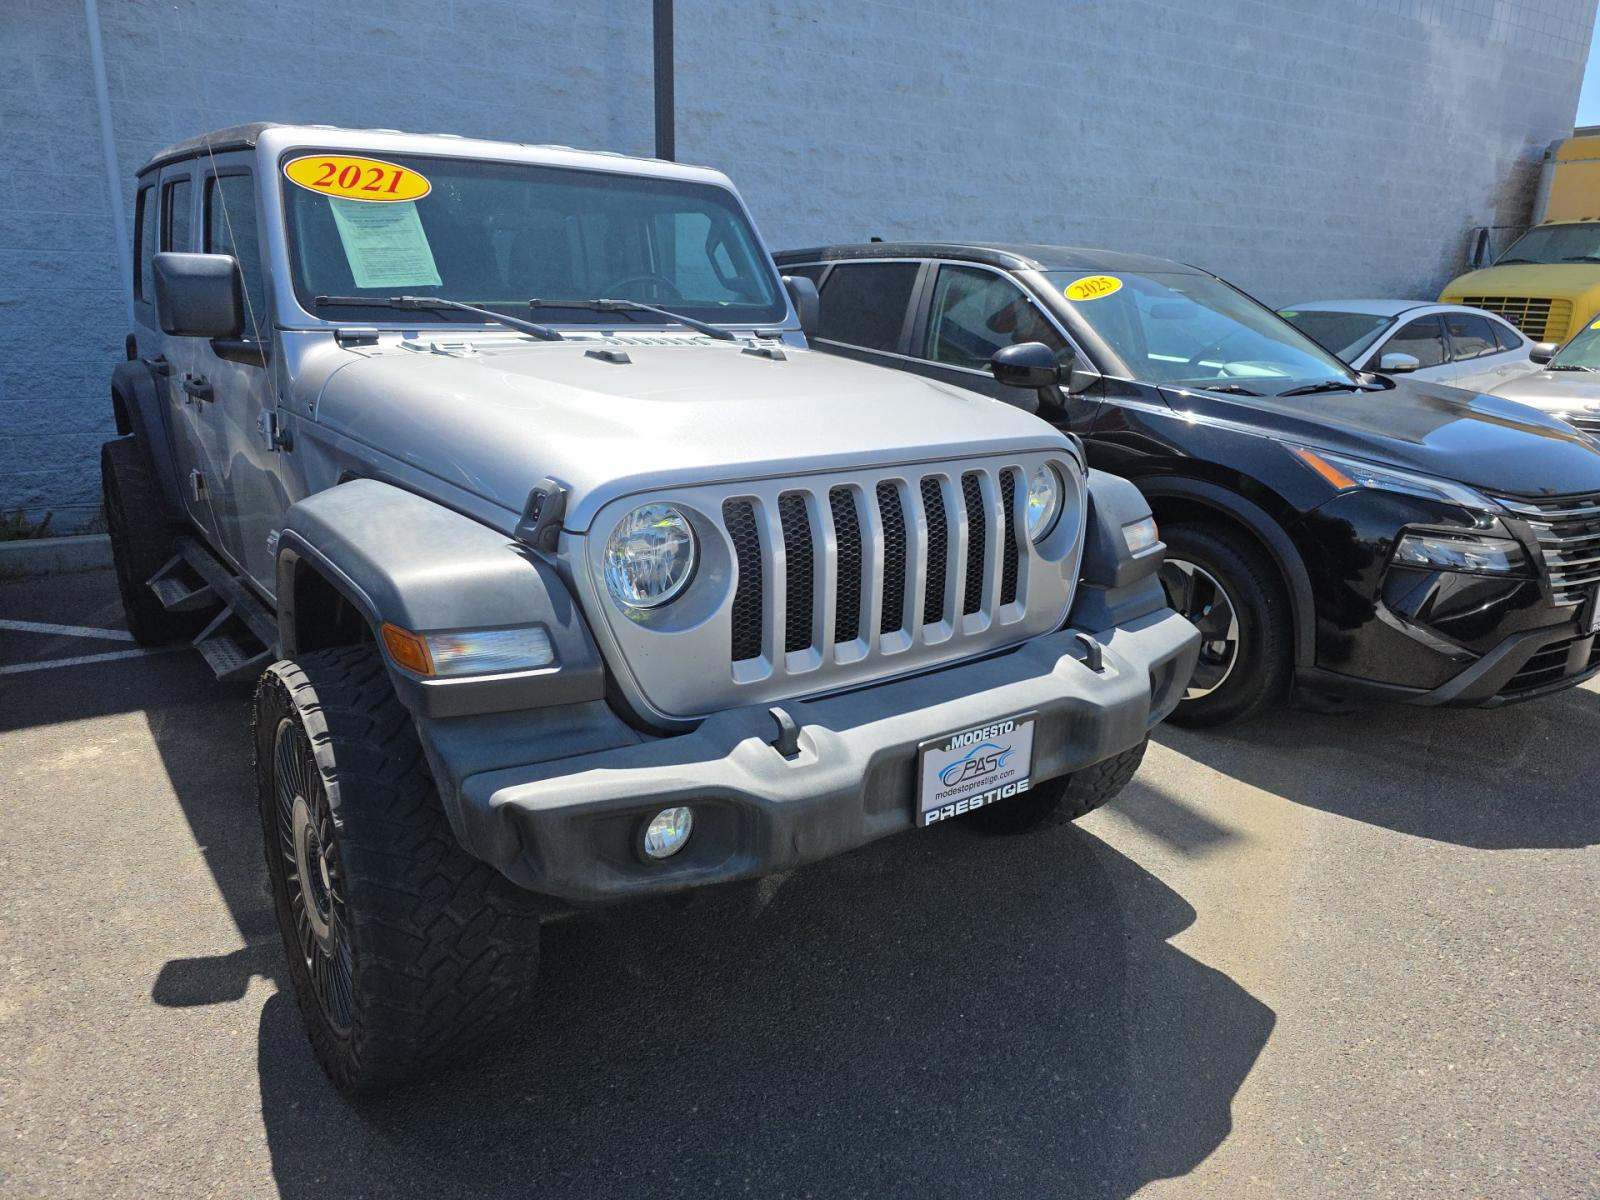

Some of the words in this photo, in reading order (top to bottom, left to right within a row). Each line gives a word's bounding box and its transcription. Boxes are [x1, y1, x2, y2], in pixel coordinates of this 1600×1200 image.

[312, 162, 403, 193] 2021
[1075, 277, 1112, 297] 2025
[951, 721, 1014, 750] MODESTO
[935, 769, 1015, 800] modestoprestige.com
[925, 778, 1030, 826] PRESTIGE
